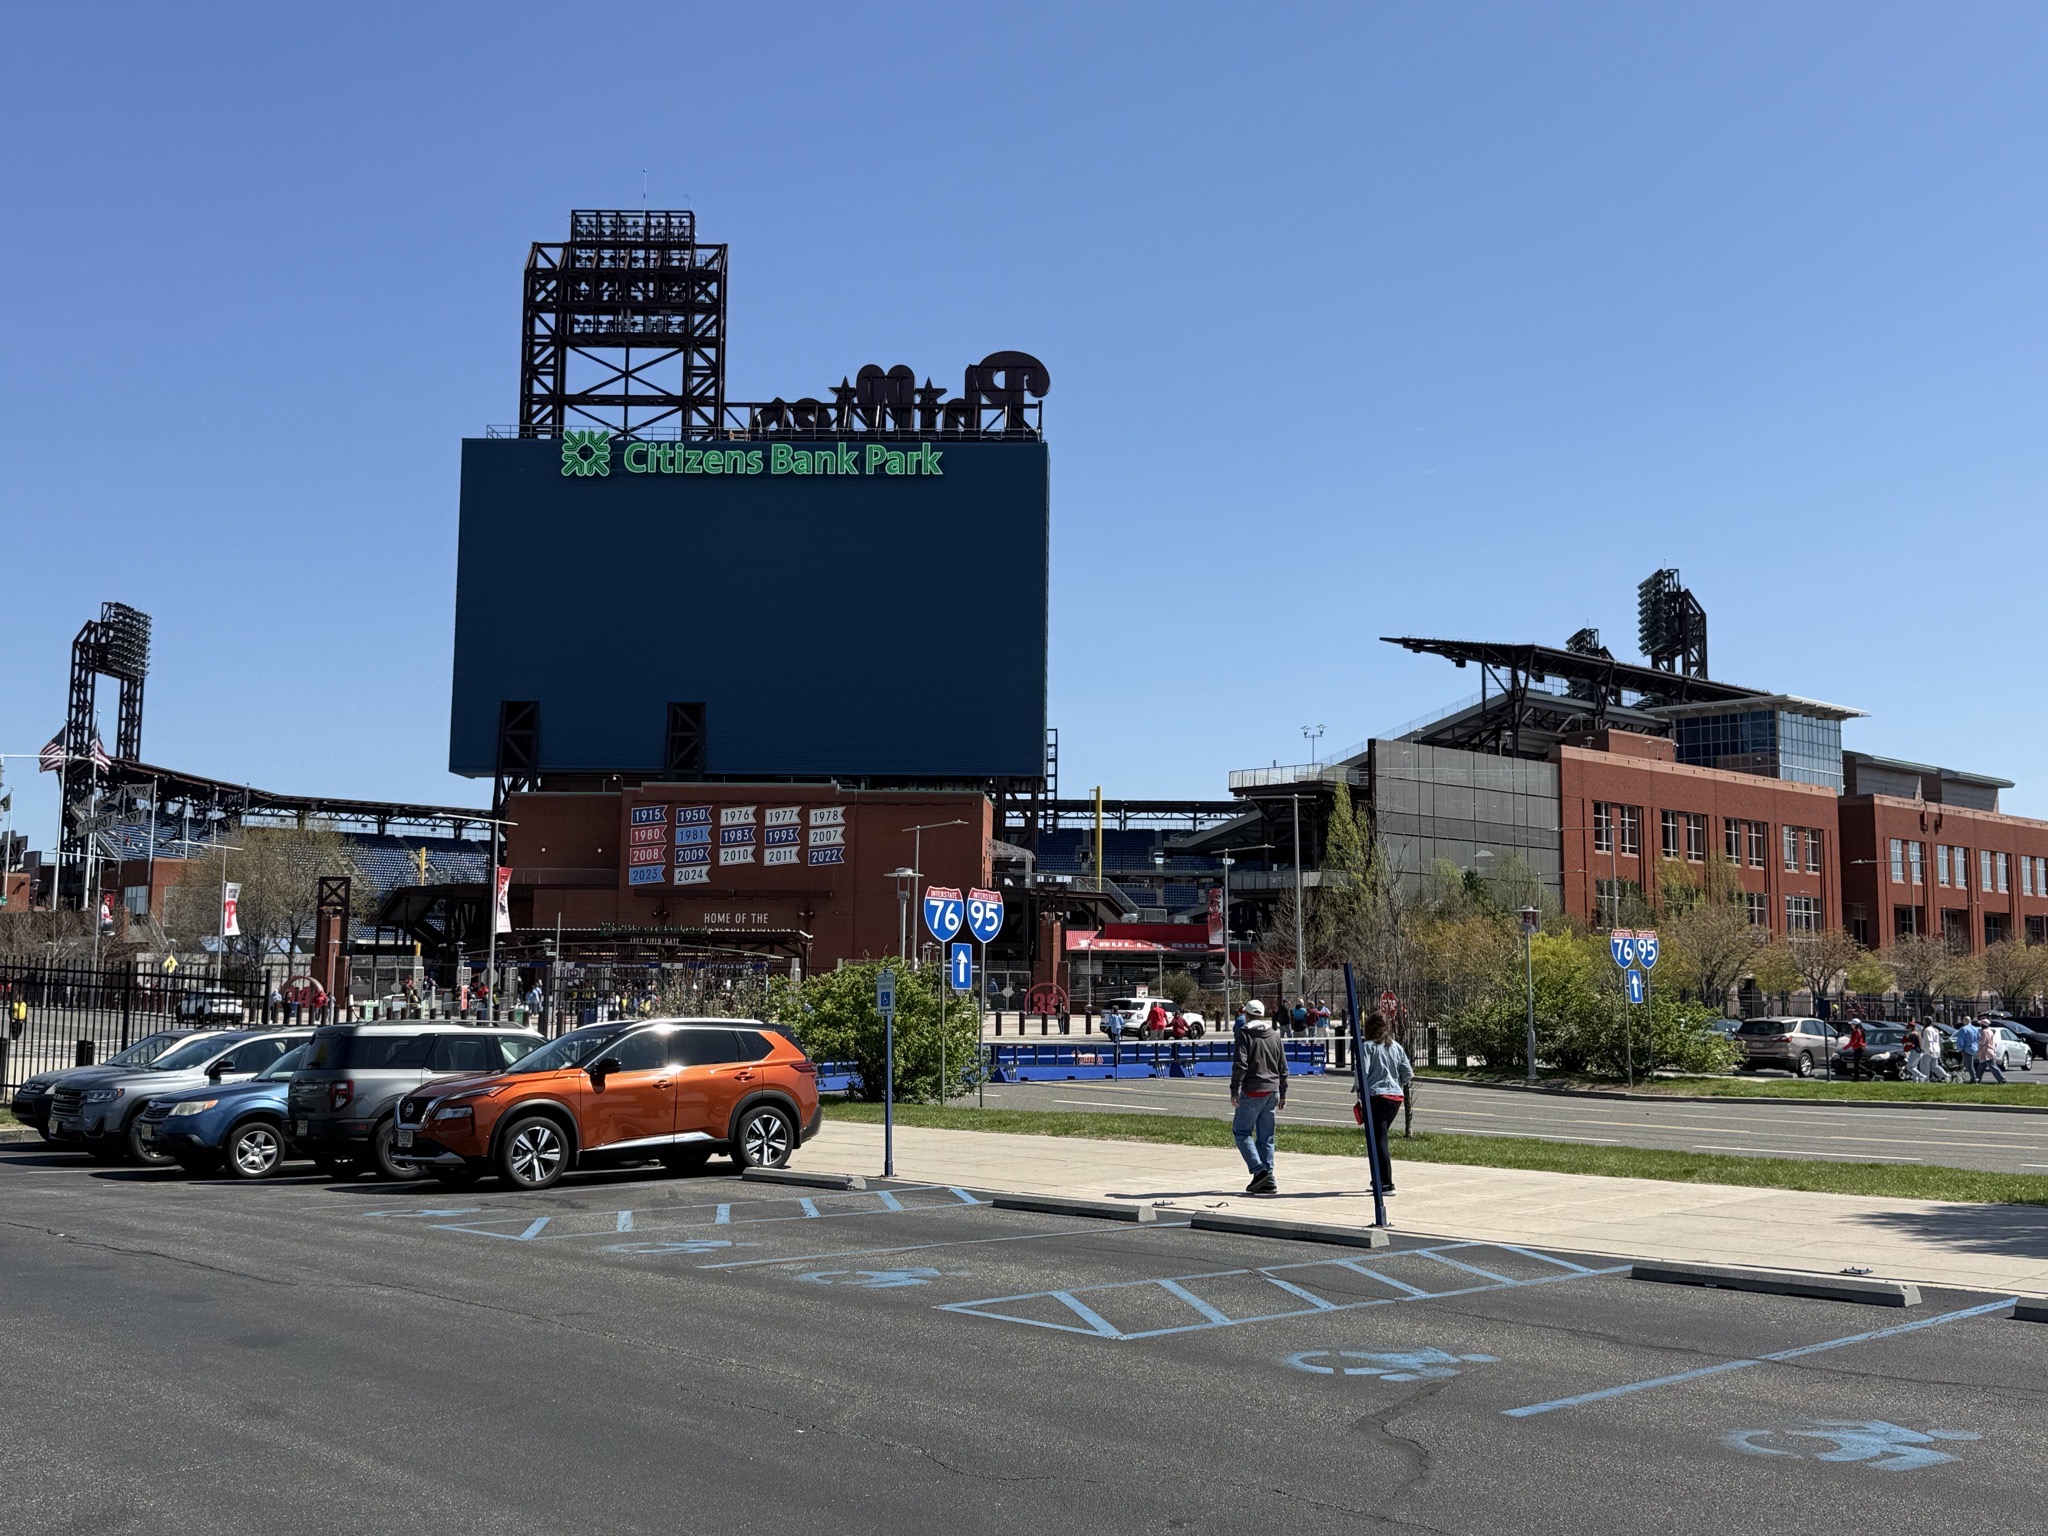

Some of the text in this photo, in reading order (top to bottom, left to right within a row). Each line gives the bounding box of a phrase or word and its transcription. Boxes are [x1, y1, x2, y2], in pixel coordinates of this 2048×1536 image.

[624, 442, 943, 475] Citizens Bank Park
[634, 809, 661, 822] 1915
[680, 808, 705, 822] 1950
[724, 809, 750, 822] 1976
[769, 810, 794, 823] 1977
[813, 810, 838, 823] 1978
[634, 828, 660, 842] 1980
[680, 828, 704, 842] 1981
[723, 829, 749, 842] 1983
[768, 829, 794, 842] 1993
[812, 830, 838, 843] 2007
[633, 848, 659, 861] 2008
[678, 848, 703, 861] 2009
[723, 848, 748, 862] 2010
[768, 848, 793, 862] 2011
[811, 849, 837, 862] 2022
[632, 867, 658, 881] 2023
[677, 868, 703, 881] 2024
[931, 890, 958, 900] INTERSTATE
[972, 892, 998, 902] INTERSTATE
[704, 912, 768, 924] HOME OF THE
[930, 900, 959, 931] 76
[970, 902, 998, 932] 95
[1614, 940, 1632, 960] 76
[1638, 940, 1656, 960] 95
[1033, 993, 1058, 1015] 32
